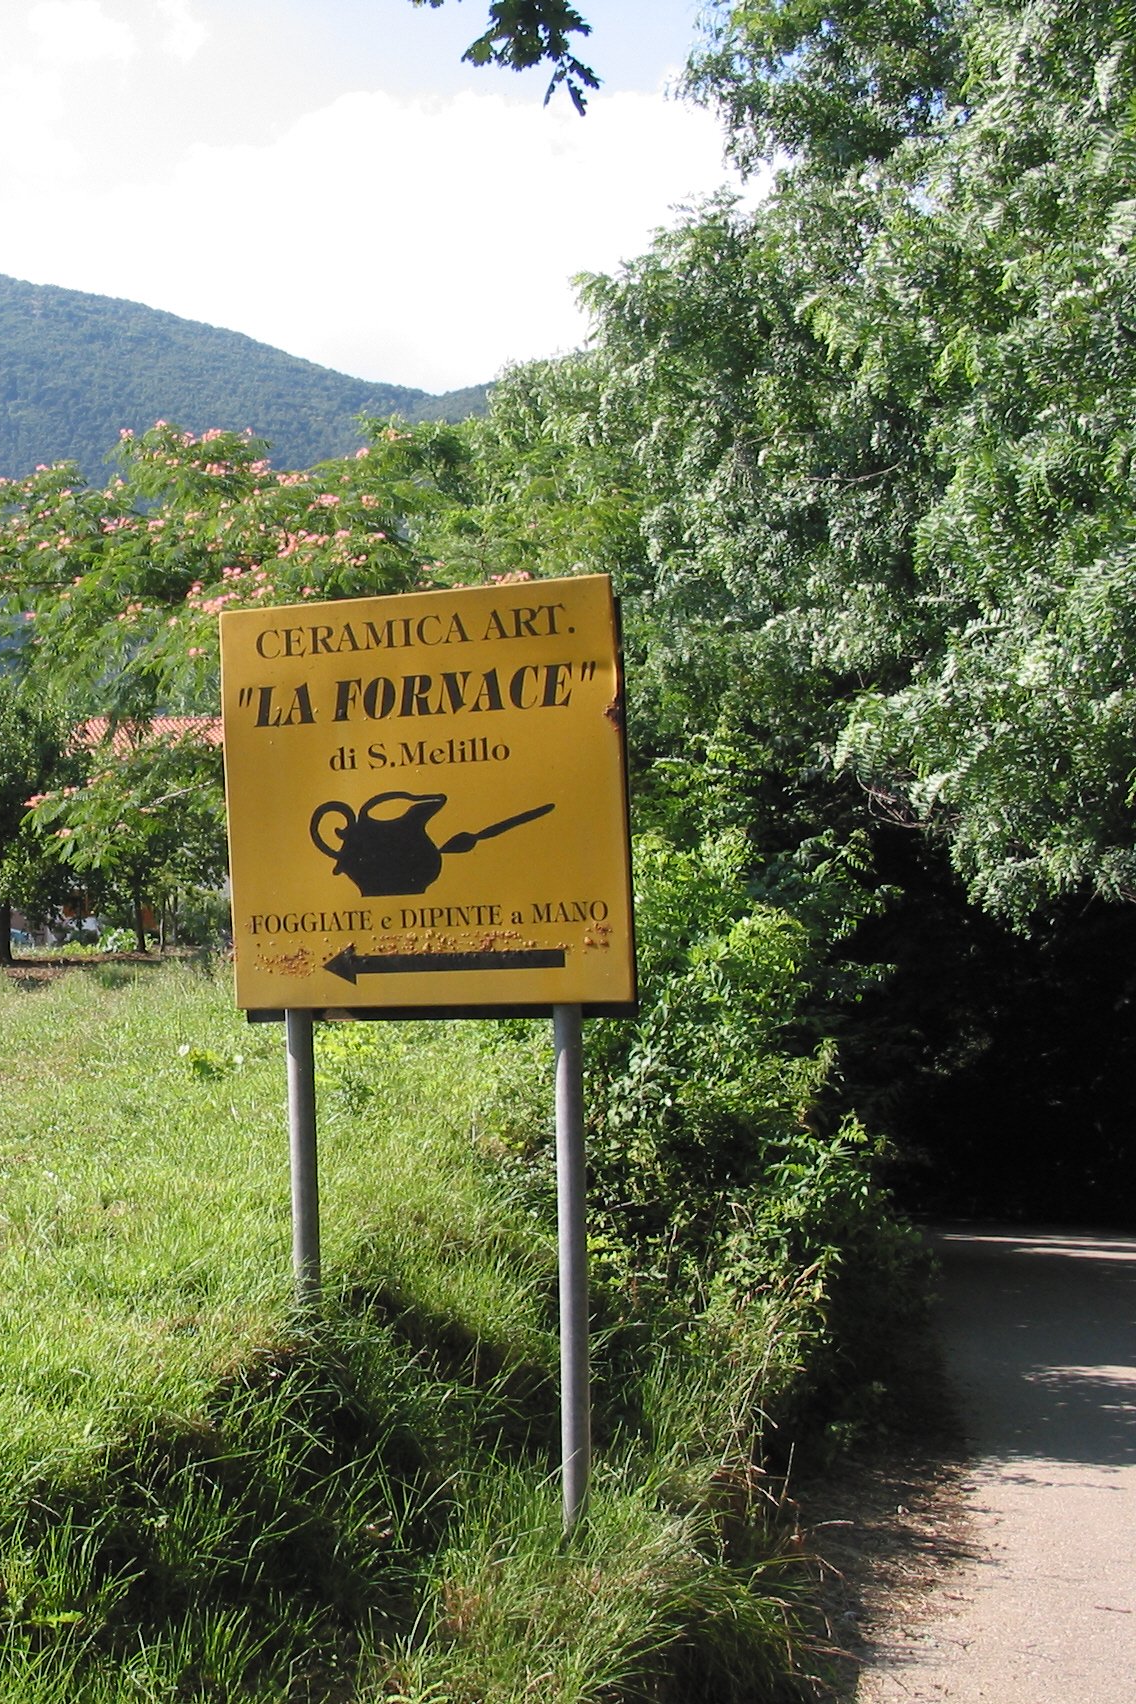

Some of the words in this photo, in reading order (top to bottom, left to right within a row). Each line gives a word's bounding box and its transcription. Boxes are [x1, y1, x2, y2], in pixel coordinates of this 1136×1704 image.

[255, 612, 469, 660] CERAMICA
[483, 602, 576, 640] ART.
[237, 681, 317, 728] "LA
[331, 660, 597, 723] FORNACE"
[329, 746, 357, 772] di
[368, 737, 511, 770] S.Melillo
[250, 909, 374, 935] FOGGIATE
[380, 915, 393, 929] e
[400, 904, 504, 929] DIPINTE
[510, 910, 524, 926] a
[531, 900, 609, 925] MANO
